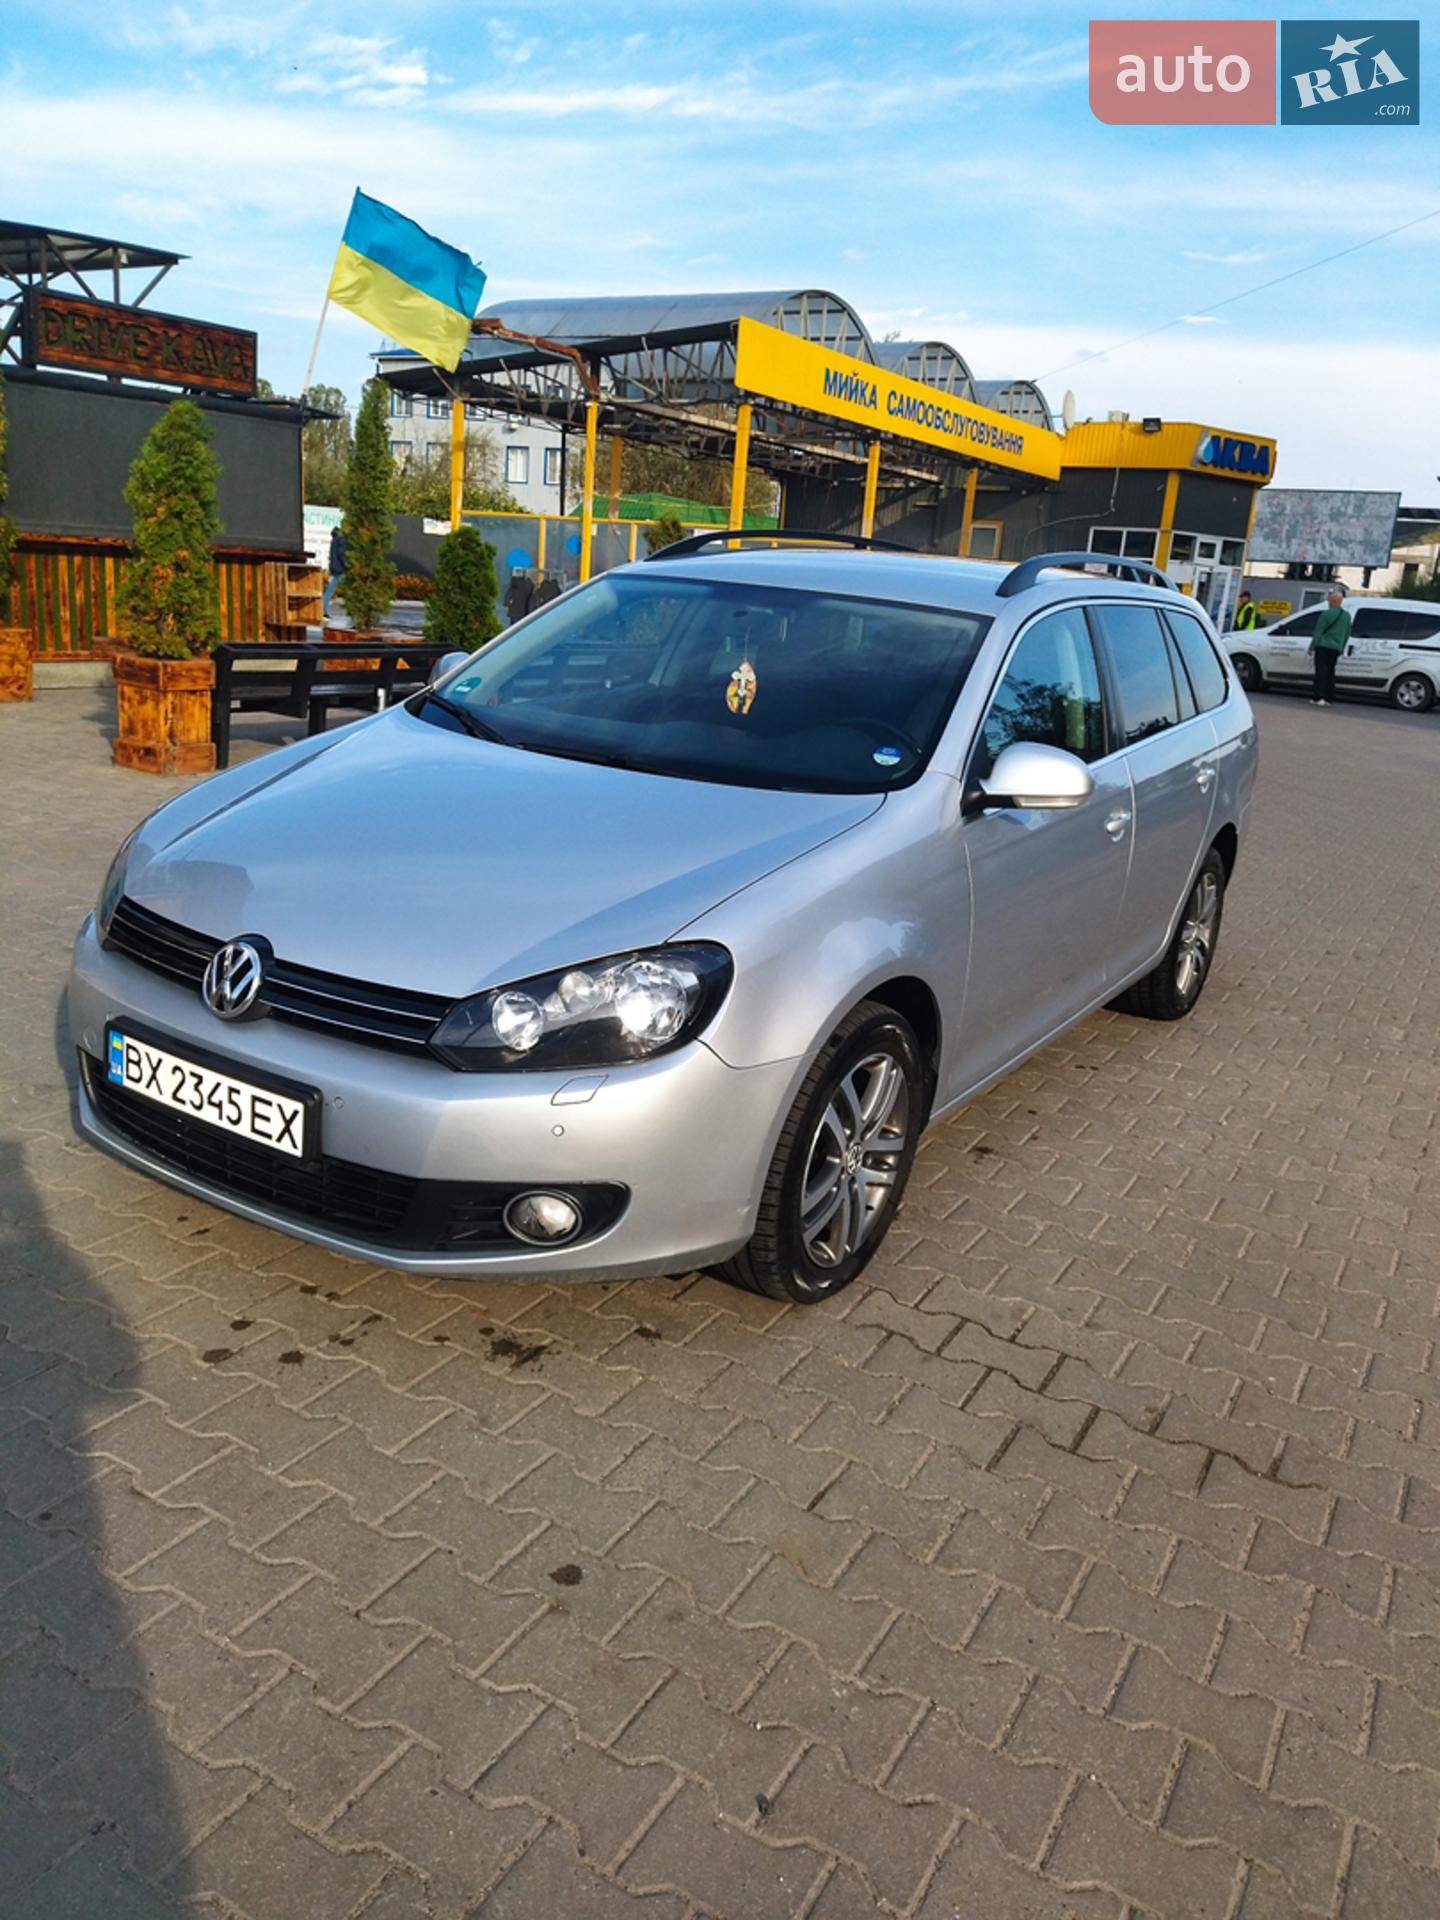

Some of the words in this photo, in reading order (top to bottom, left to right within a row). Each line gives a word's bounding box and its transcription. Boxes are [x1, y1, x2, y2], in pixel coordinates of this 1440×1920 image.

[40, 306, 151, 366] DRIVE
[160, 329, 248, 381] KAVA
[823, 367, 878, 411] МИЙКА
[886, 390, 1025, 456] САМООБСЛУГОВУВАННЯ
[125, 1042, 163, 1096] BX
[171, 1065, 242, 1127] 2345
[250, 1094, 300, 1150] EX
